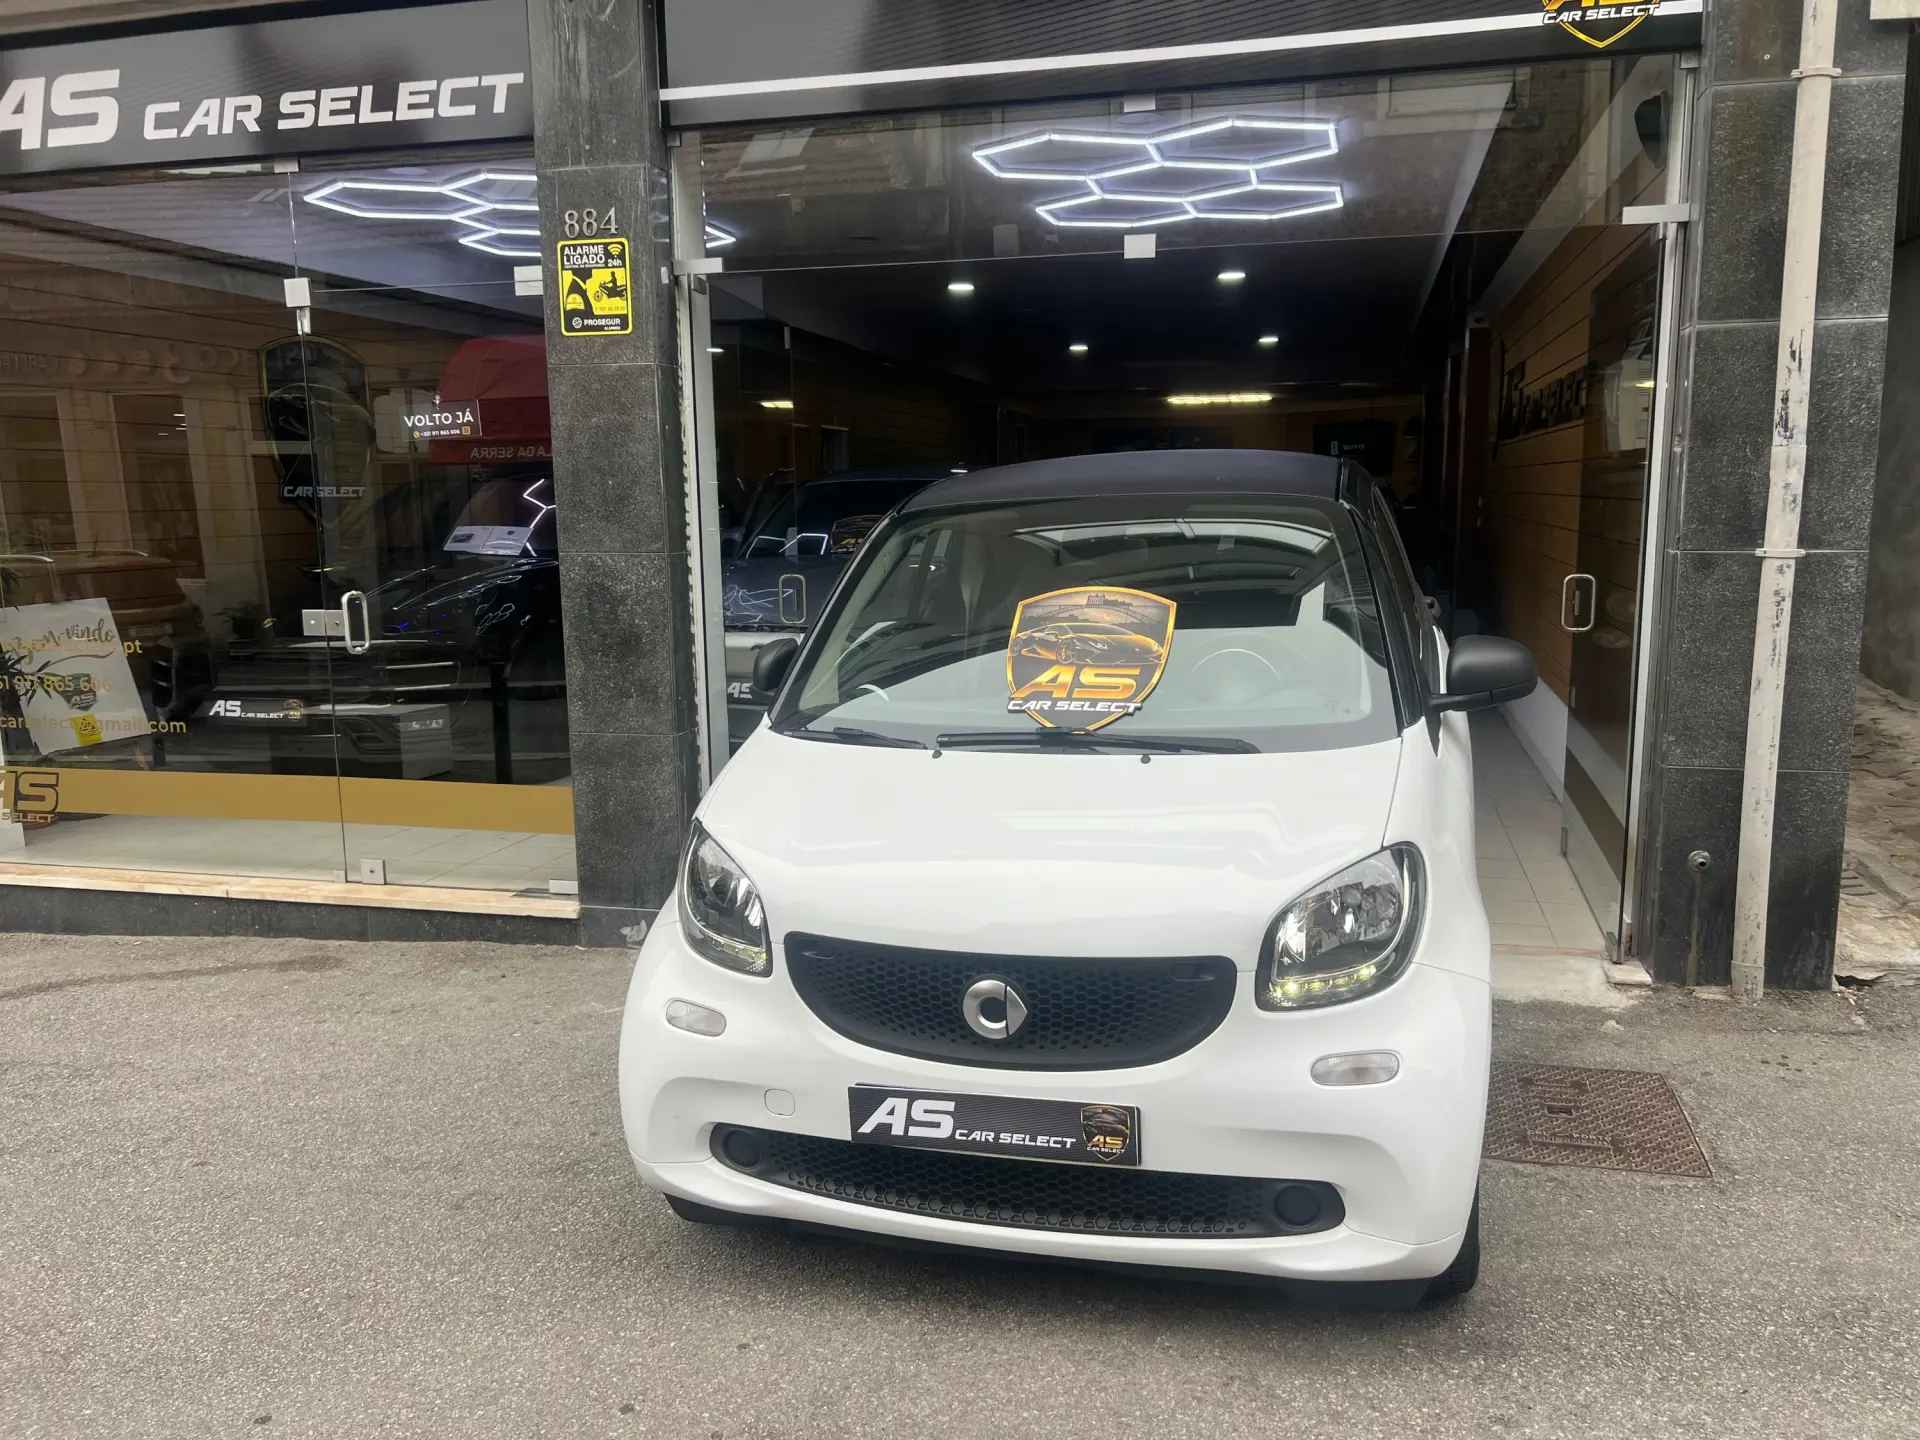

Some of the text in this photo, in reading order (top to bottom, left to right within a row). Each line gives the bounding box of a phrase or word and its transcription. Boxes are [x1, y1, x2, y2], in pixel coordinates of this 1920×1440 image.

[1543, 10, 1581, 24] CAR
[1585, 4, 1660, 21] SELECT
[0, 68, 525, 150] AS CAR SELECT
[564, 206, 619, 239] 884
[563, 244, 605, 256] ALARME
[563, 254, 623, 267] LIGADO 24h
[583, 318, 621, 326] PROSEGUR
[404, 408, 474, 428] VOLTO JÁ
[283, 486, 366, 498] CAR SELECT
[43, 676, 75, 692] 865
[1010, 664, 1142, 700] AS
[208, 699, 242, 718] AS
[1007, 700, 1142, 714] CAR SELECT
[1, 811, 55, 823] SELECT
[857, 1096, 1077, 1149] AS CAR SELECT
[1087, 1134, 1124, 1149] AS
